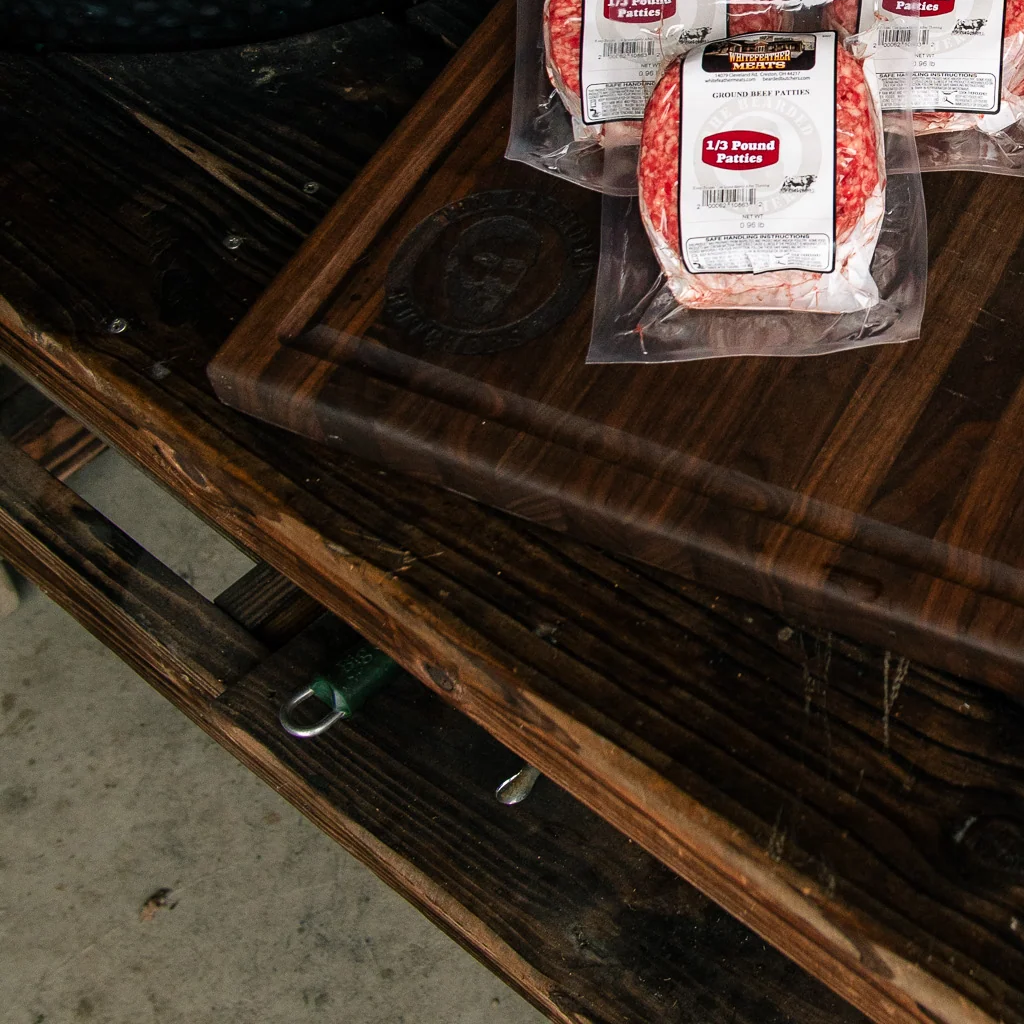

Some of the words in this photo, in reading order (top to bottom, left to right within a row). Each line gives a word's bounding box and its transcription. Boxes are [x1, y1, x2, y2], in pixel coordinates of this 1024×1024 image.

[617, 7, 661, 18] Patties
[729, 50, 791, 63] WHITEFEATHER
[731, 61, 786, 71] MEATS
[705, 140, 728, 151] 1/3
[731, 140, 776, 151] Pound
[716, 153, 763, 164] Patties
